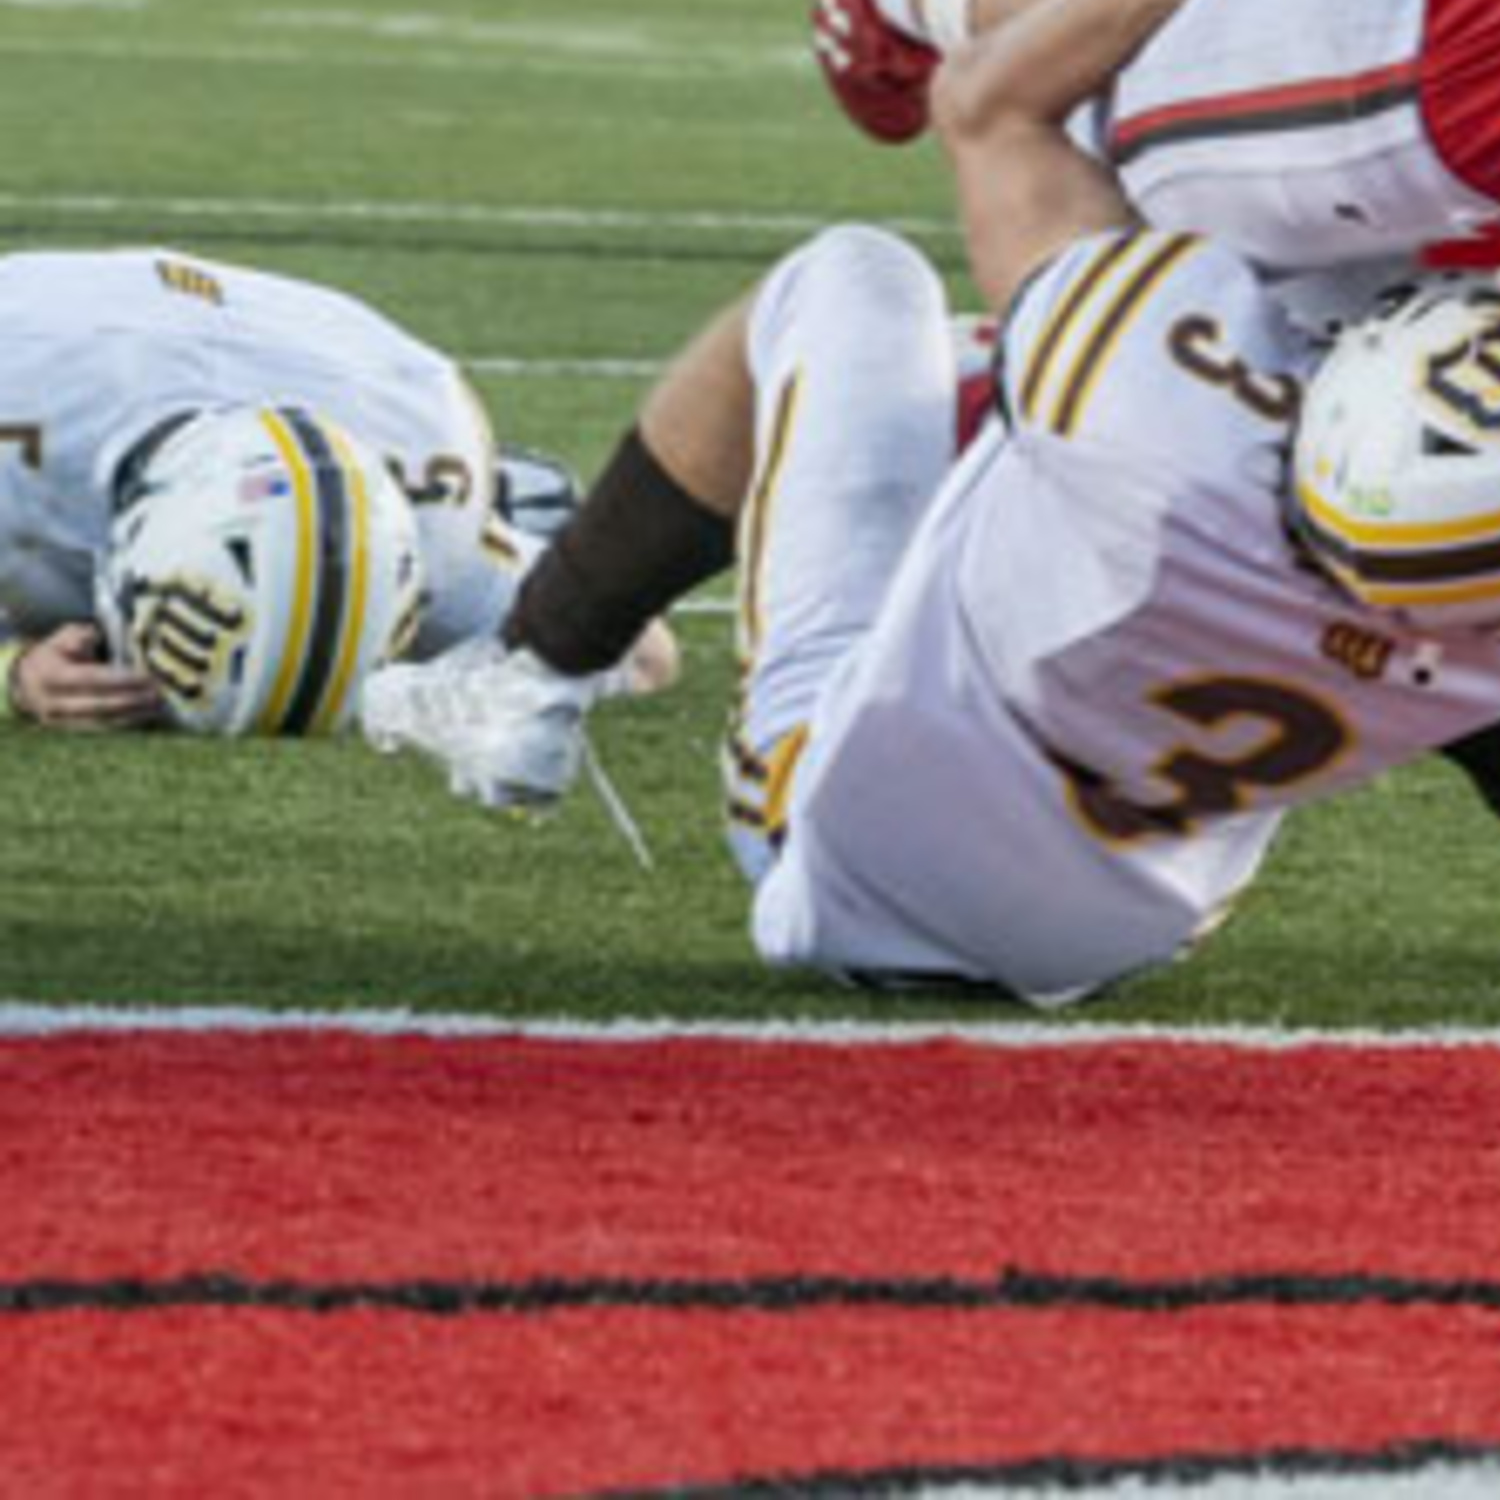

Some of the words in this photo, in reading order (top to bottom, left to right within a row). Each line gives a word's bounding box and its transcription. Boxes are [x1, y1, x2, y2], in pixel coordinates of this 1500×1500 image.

[1166, 313, 1303, 424] 3
[384, 453, 471, 508] 5
[1068, 672, 1354, 850] 3
